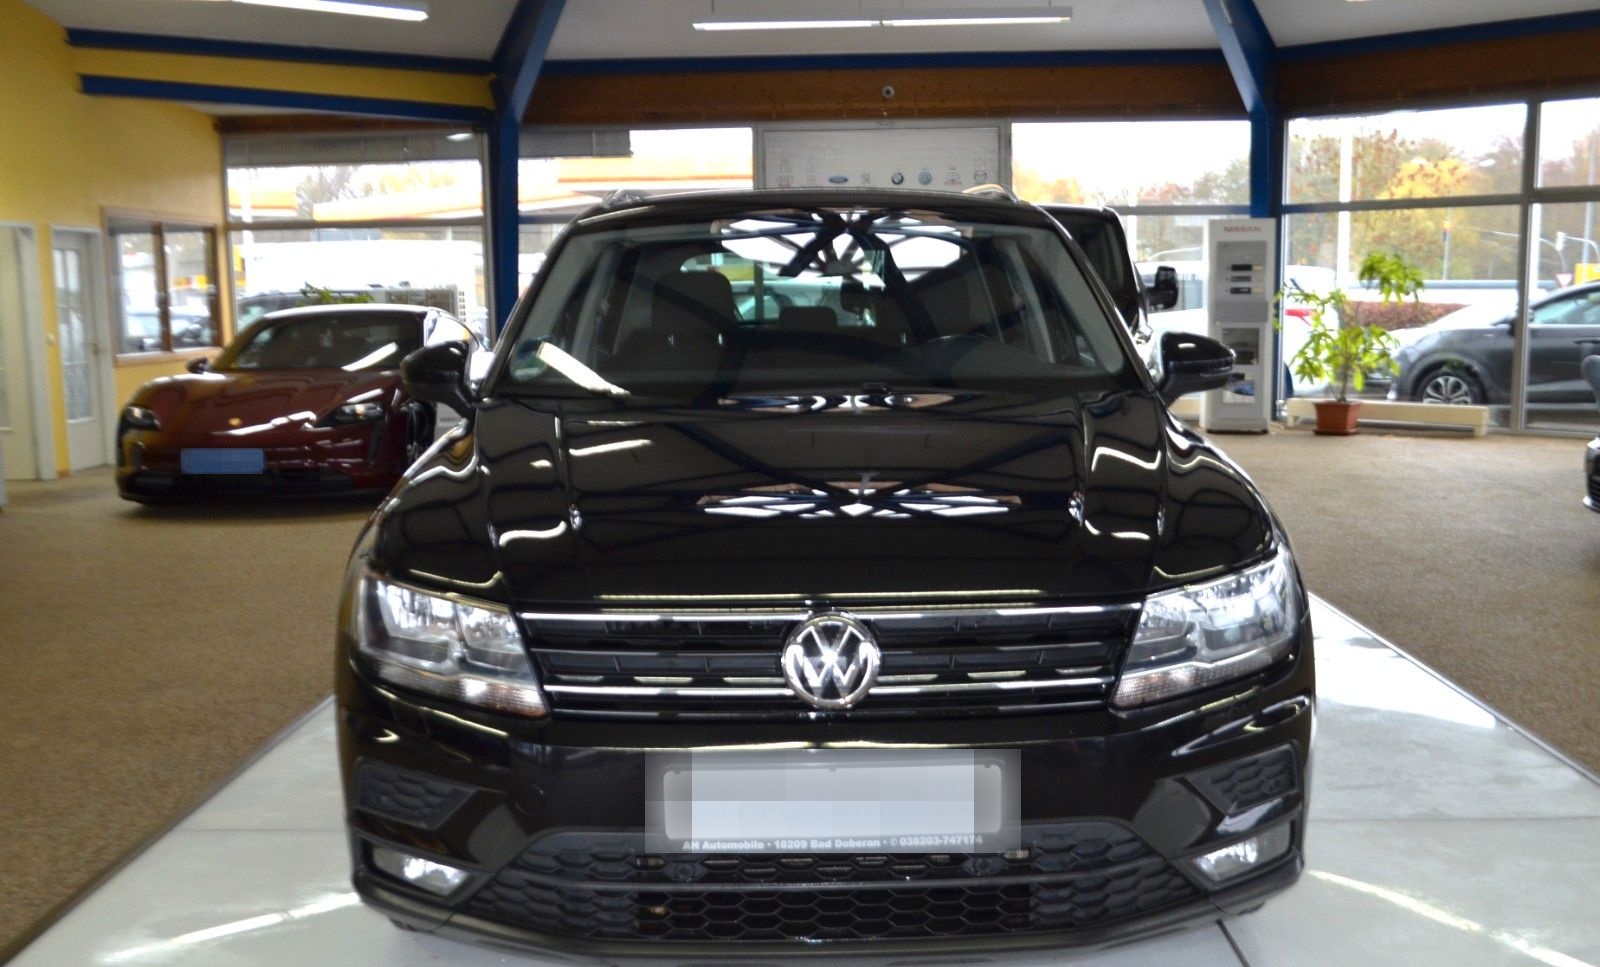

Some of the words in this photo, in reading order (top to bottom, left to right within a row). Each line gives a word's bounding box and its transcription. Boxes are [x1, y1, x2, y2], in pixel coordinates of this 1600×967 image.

[1223, 225, 1261, 233] NISSAN
[682, 840, 700, 850] AH
[702, 839, 766, 850] Automobile
[774, 839, 809, 849] 18209
[811, 839, 832, 849] Bad
[834, 838, 881, 848] Doberan
[899, 835, 984, 846] 038203-747174
